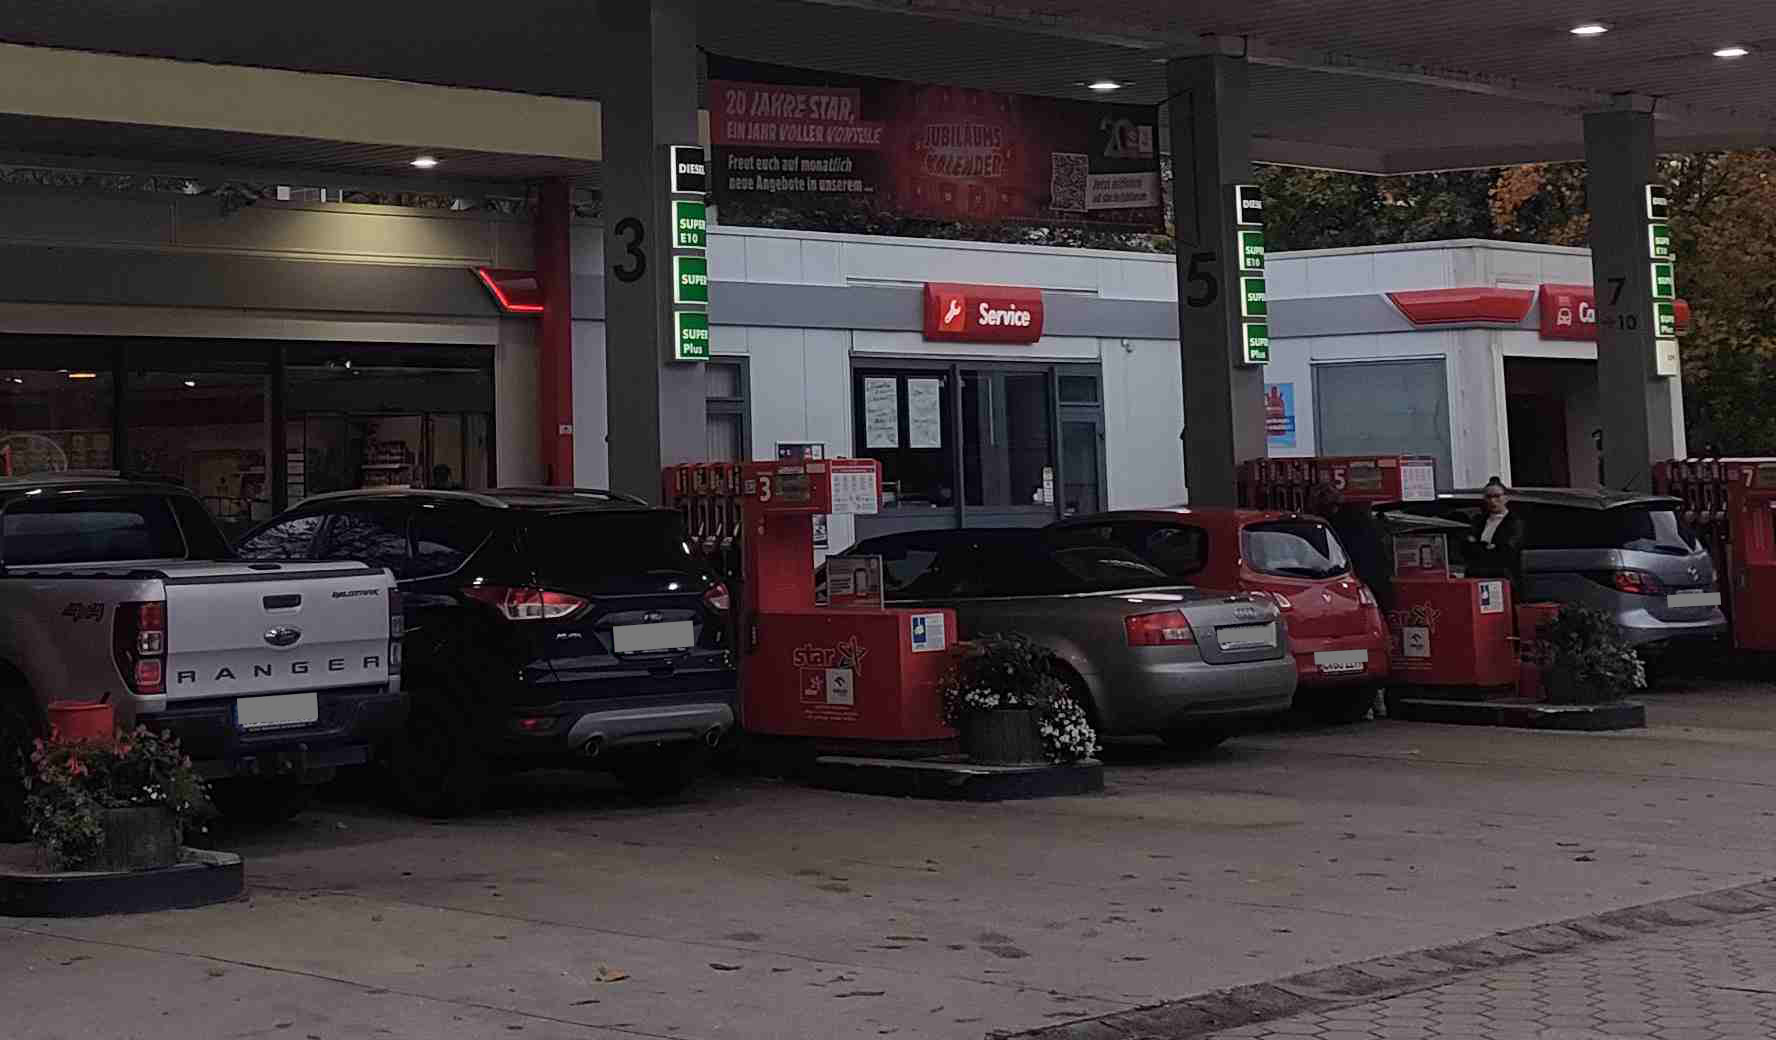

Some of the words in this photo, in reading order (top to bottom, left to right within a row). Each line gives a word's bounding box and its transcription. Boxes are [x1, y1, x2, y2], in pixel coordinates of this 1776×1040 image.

[726, 89, 746, 115] 20
[750, 91, 807, 119] JAHRE
[727, 121, 746, 141] EIN
[747, 122, 777, 142] JAHR
[779, 123, 824, 143] VOLLER
[826, 126, 882, 145] VORTEILE
[728, 154, 755, 171] Freut
[756, 156, 780, 172] euch
[781, 156, 800, 172] auf
[800, 156, 853, 173] monatlich
[728, 177, 754, 191] neue
[756, 175, 806, 193] Angebote
[818, 177, 863, 192] unserem
[613, 216, 647, 283] 3
[680, 232, 699, 244] E10
[1187, 251, 1218, 308] 5
[978, 302, 1032, 328] Service
[683, 342, 704, 356] Plus
[758, 475, 772, 503] 3
[1333, 468, 1347, 490] 5
[1743, 468, 1754, 489] 7
[176, 655, 381, 685] RANGER
